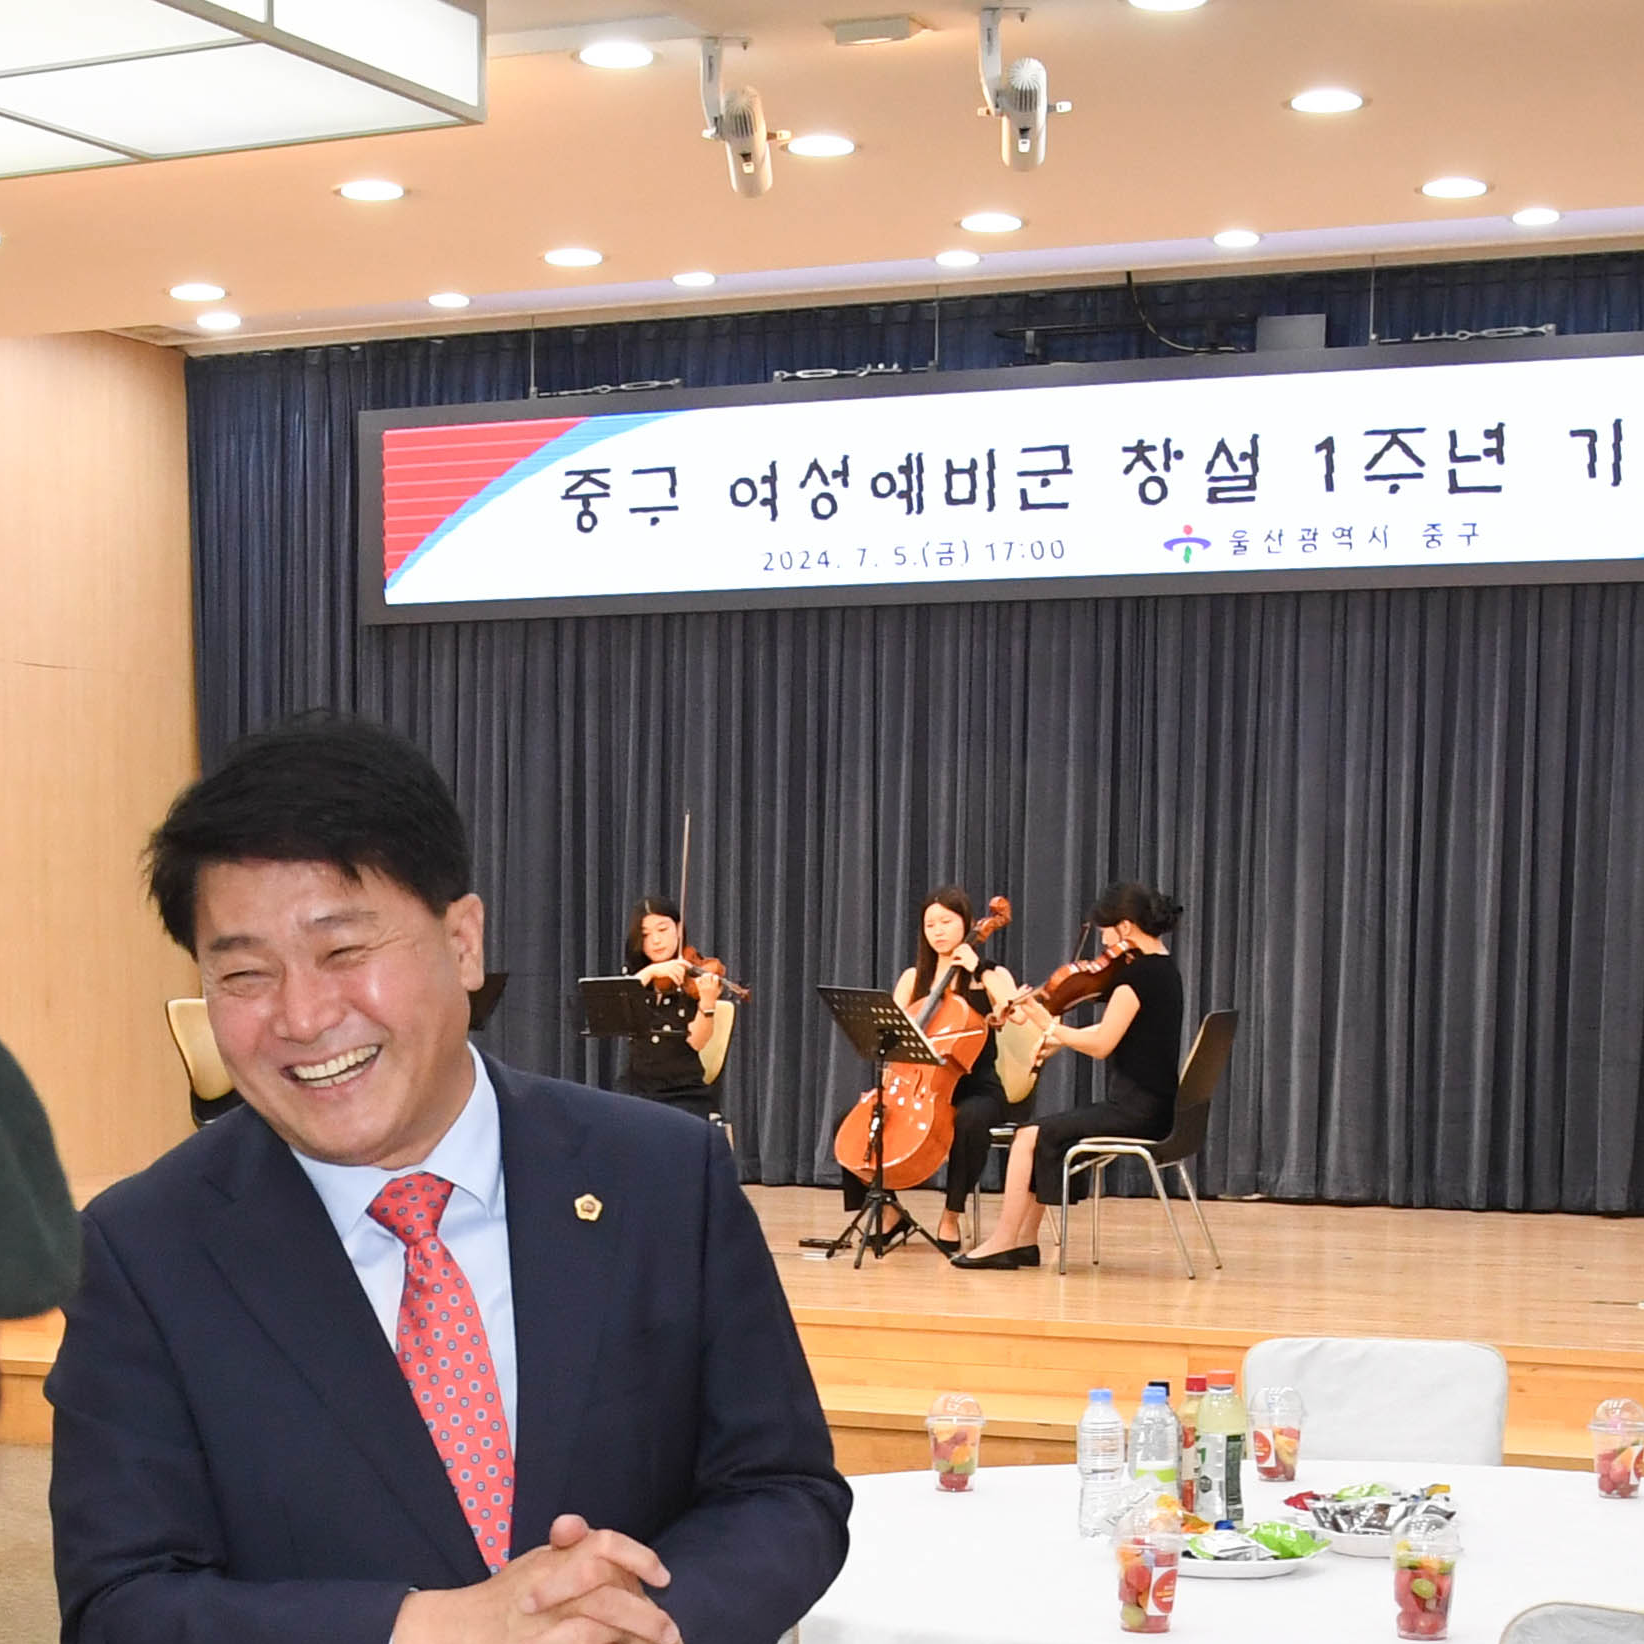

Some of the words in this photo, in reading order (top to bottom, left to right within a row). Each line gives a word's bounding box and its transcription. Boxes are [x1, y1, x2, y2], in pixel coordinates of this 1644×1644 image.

[560, 465, 679, 534] 중구
[729, 445, 1073, 522] 여성예비군
[1122, 434, 1260, 506] 창설
[1314, 422, 1506, 495] 1주년
[985, 538, 1065, 562] 17:00
[1228, 523, 1390, 555] 울산광역시
[1422, 521, 1481, 550] 중구
